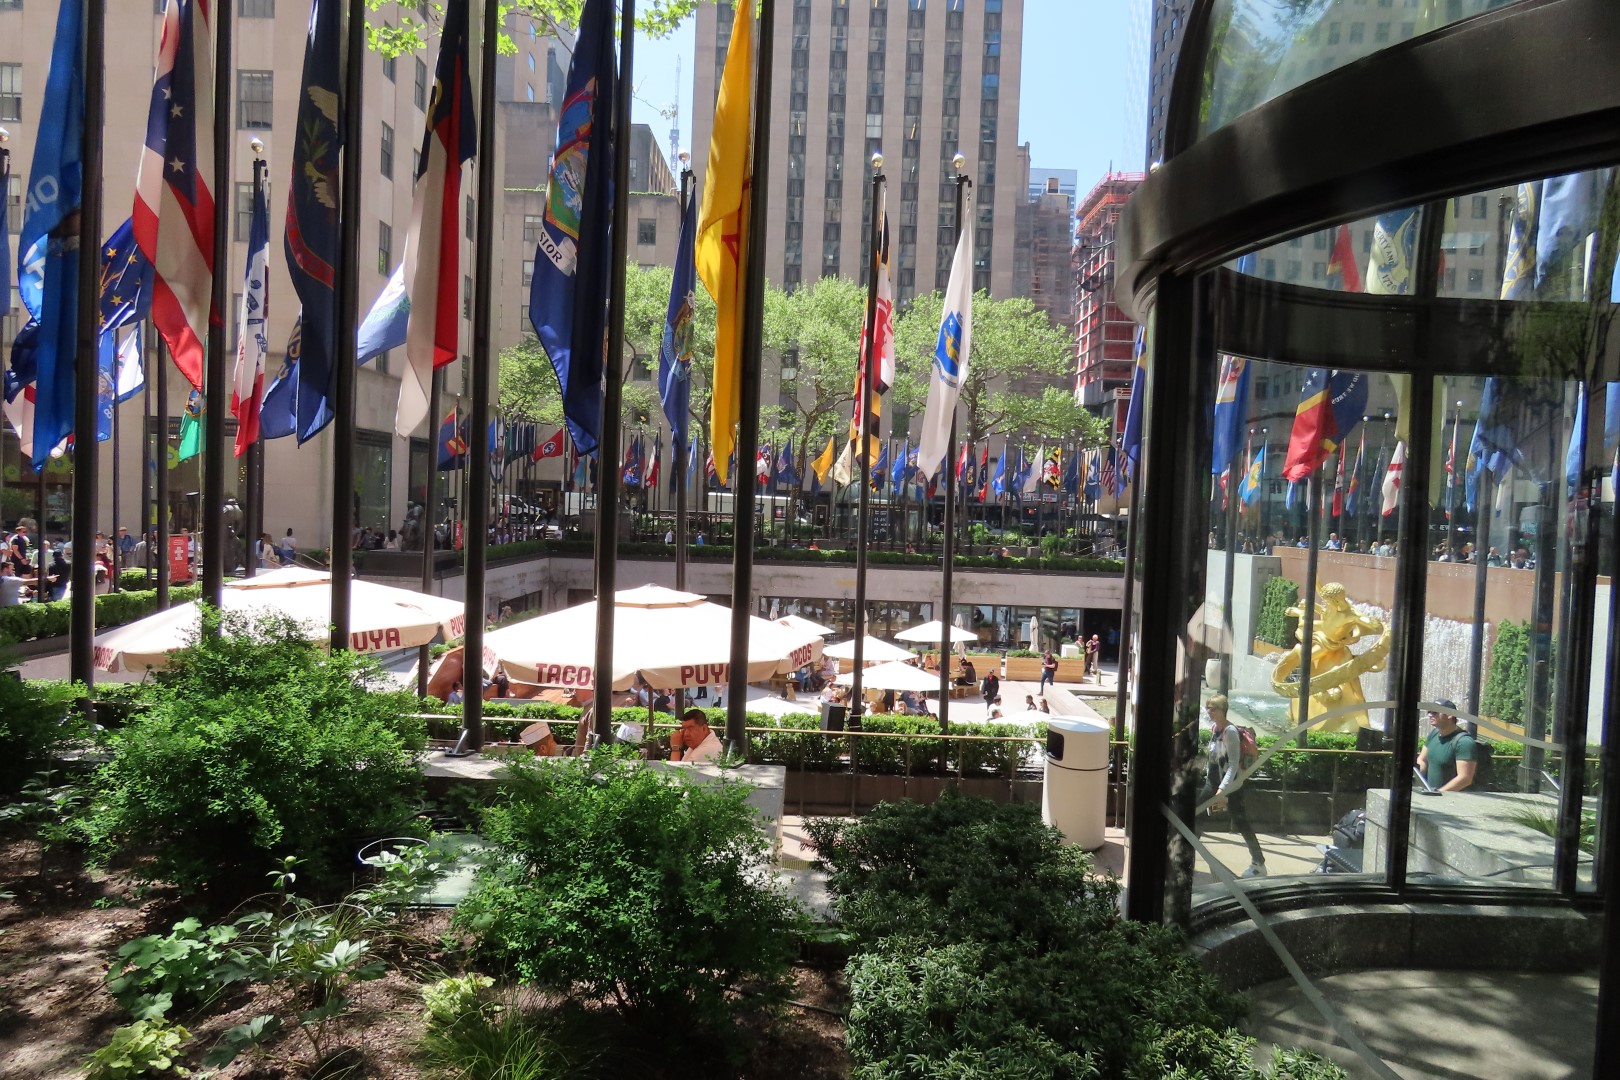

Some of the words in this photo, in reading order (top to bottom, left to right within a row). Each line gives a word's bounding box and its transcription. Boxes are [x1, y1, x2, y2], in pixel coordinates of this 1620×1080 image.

[539, 231, 563, 263] SIOR
[350, 627, 400, 651] UYA
[789, 643, 813, 669] TACOS
[535, 662, 595, 687] TACO
[680, 663, 730, 686] PUY
